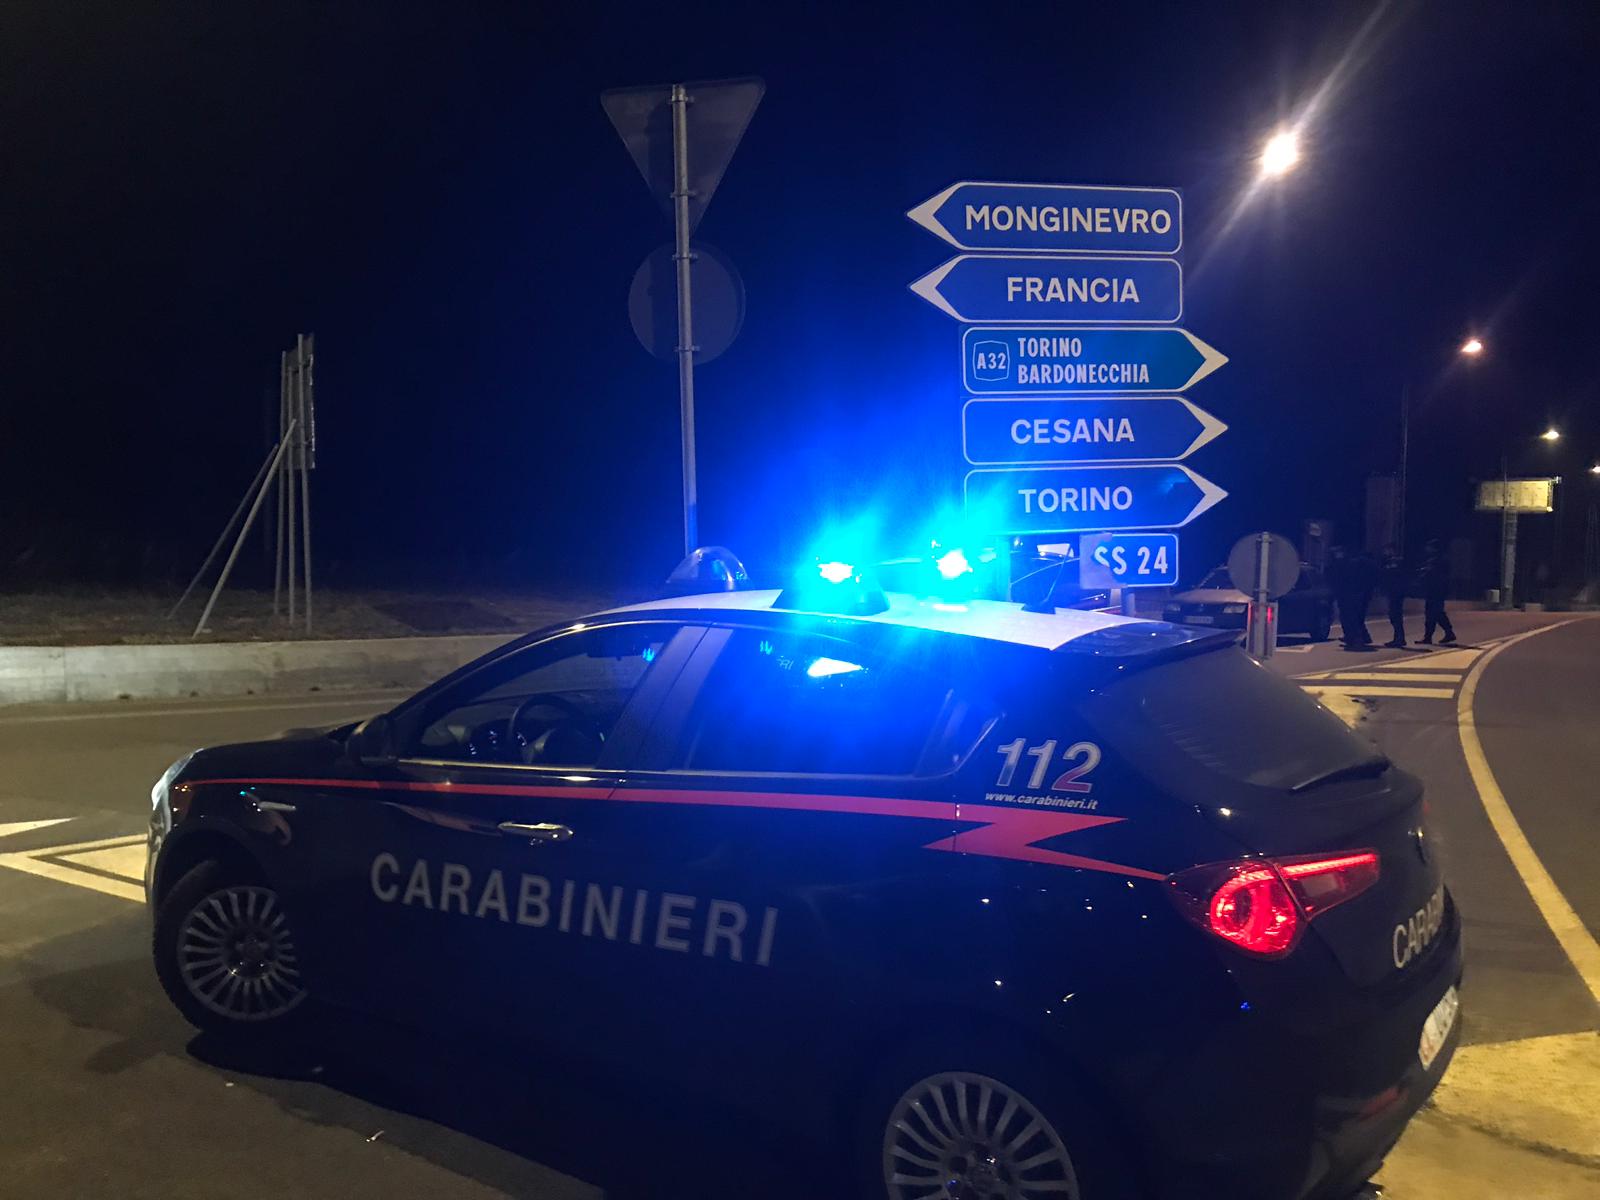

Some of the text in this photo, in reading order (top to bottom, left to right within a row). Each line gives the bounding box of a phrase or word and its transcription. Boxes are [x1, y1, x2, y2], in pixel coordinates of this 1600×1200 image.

[966, 205, 1171, 234] MONGINEVRO
[1007, 276, 1139, 304] FRANCIA
[977, 353, 1006, 370] A32
[1018, 337, 1082, 358] TORINO
[1018, 364, 1150, 385] BARDONECCHIA
[1010, 418, 1135, 444] CESANA
[1018, 486, 1133, 514] TORINO
[1094, 545, 1169, 575] SS 24
[996, 737, 1102, 793] 112
[984, 792, 1098, 810] www.carabinieri.it
[370, 852, 779, 967] CARABINIERI
